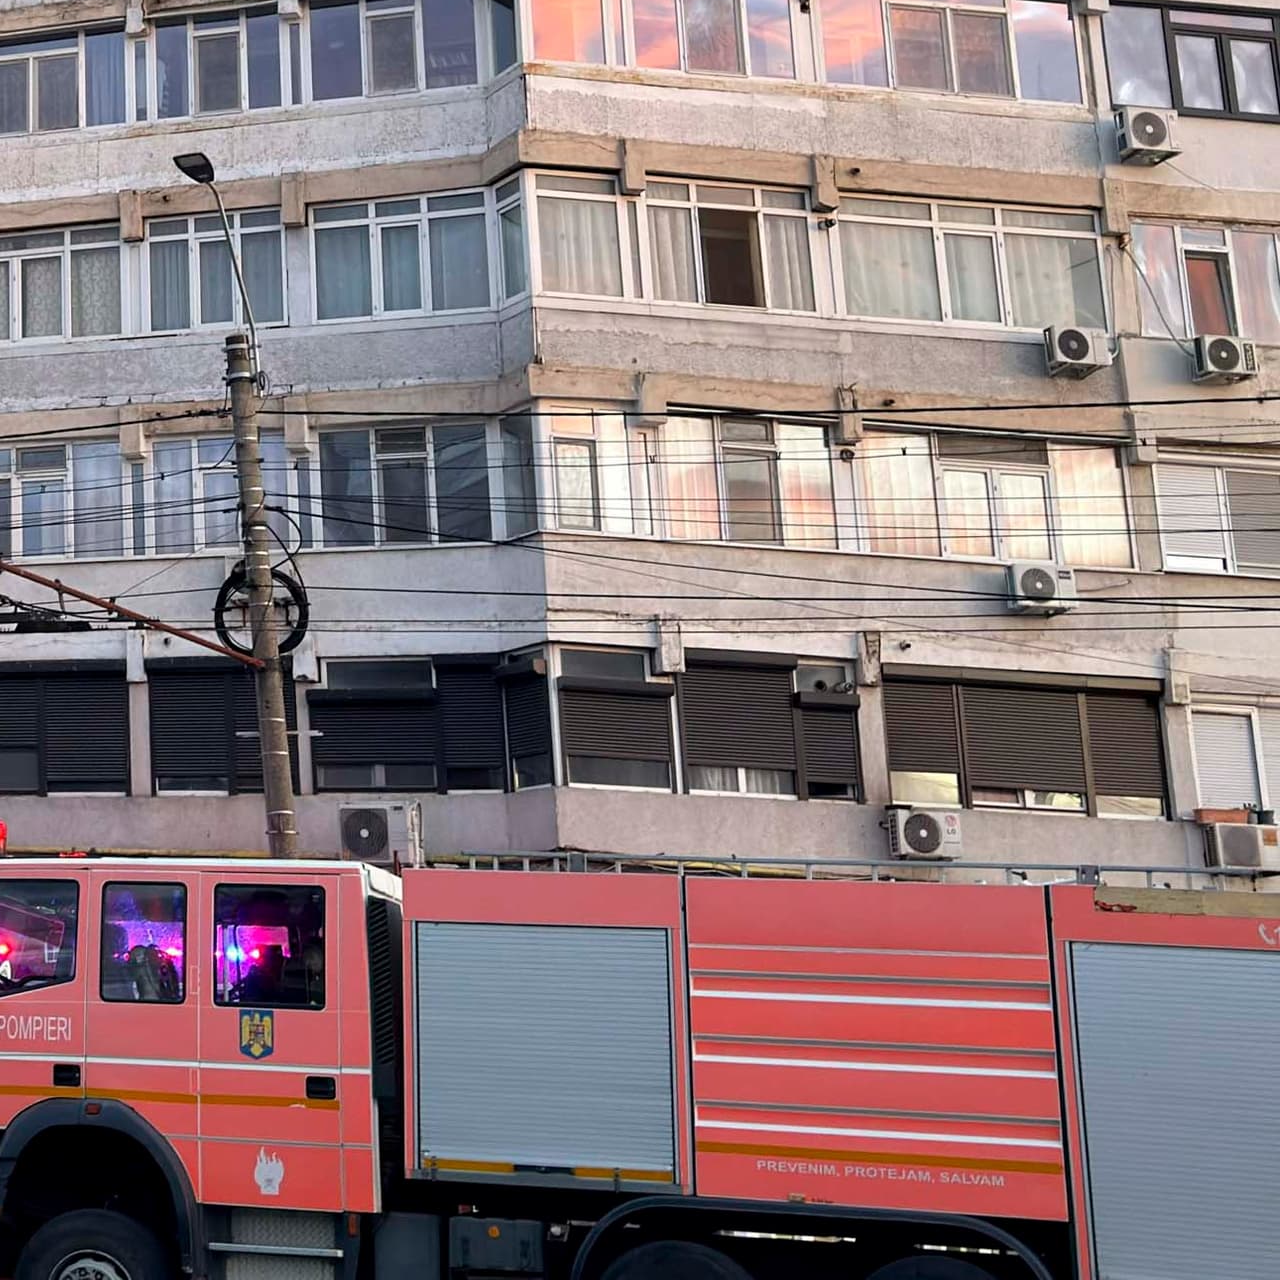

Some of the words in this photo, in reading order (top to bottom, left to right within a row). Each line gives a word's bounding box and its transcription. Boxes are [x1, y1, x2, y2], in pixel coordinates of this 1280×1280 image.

[757, 1159, 840, 1177] PREVENIM,
[844, 1166, 935, 1183] PROTEJAM,
[940, 1172, 1006, 1186] SALVAM
